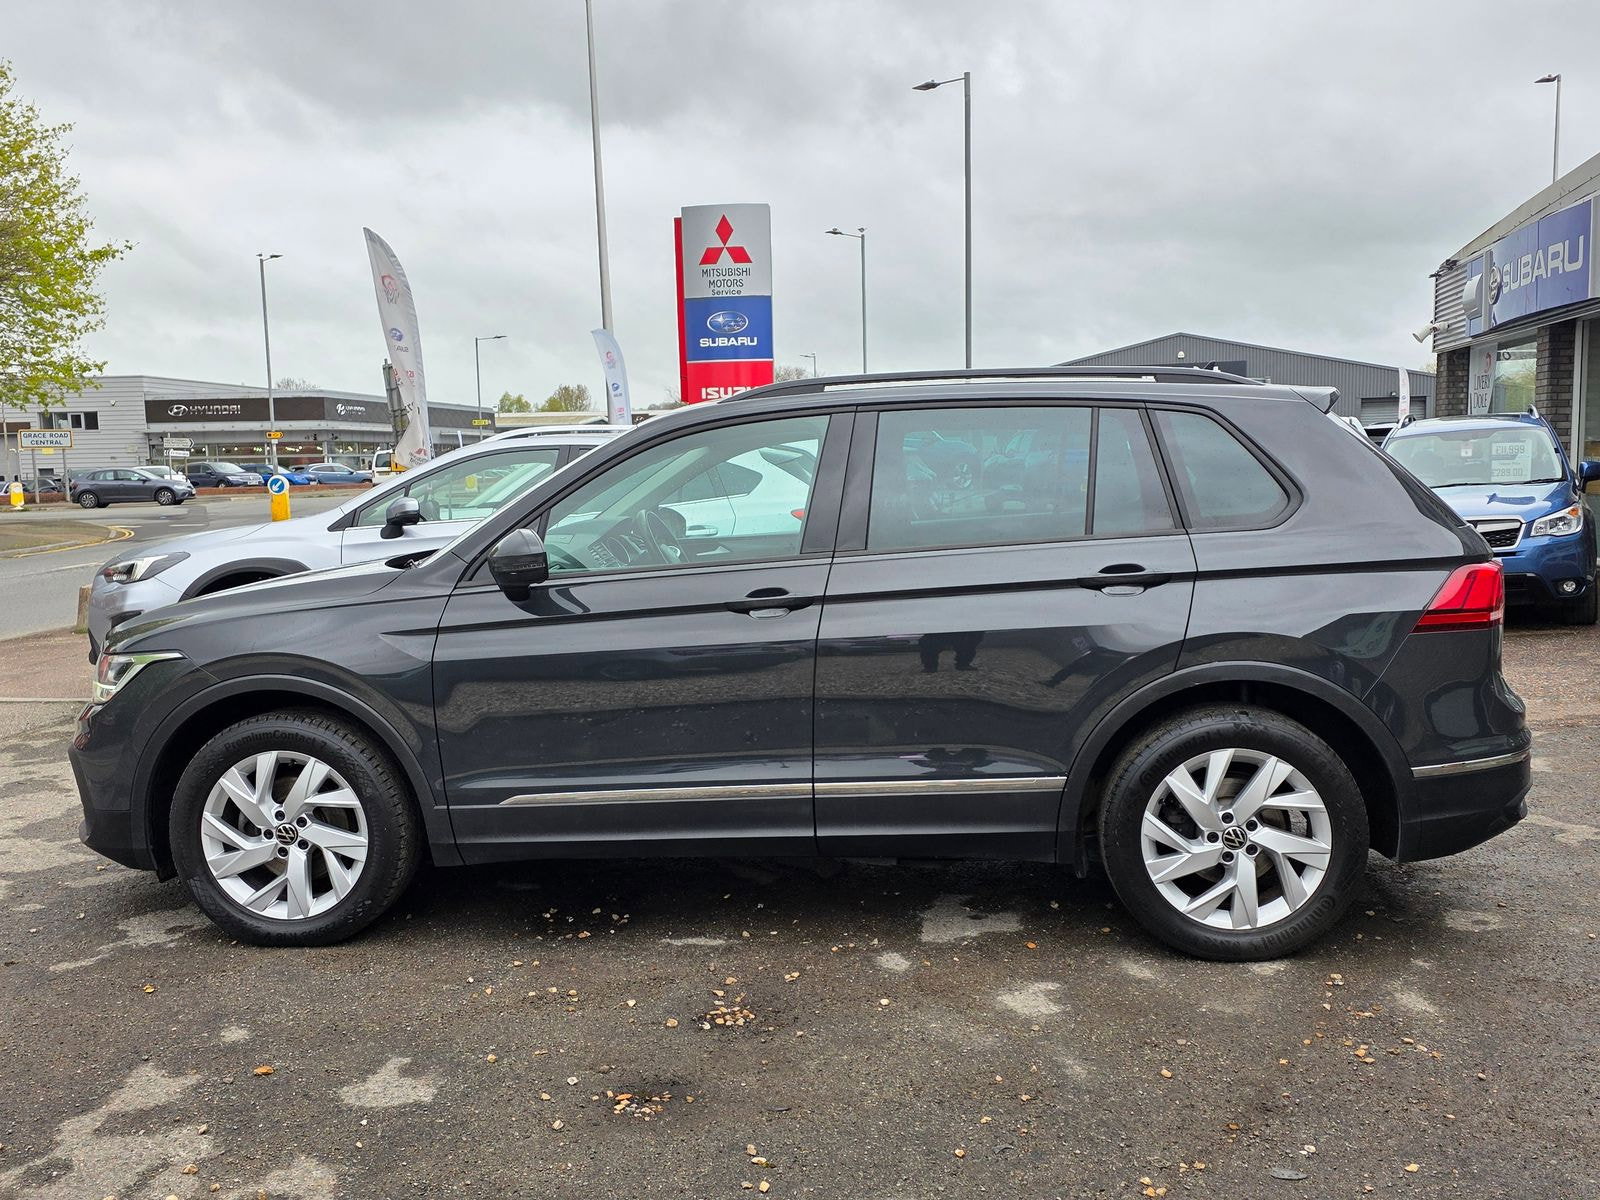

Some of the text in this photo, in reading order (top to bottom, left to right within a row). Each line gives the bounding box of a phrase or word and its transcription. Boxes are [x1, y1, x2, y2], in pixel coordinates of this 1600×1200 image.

[1501, 235, 1584, 295] SUBARU
[701, 267, 751, 278] MITSUBISHI
[708, 278, 744, 288] MOTORS
[711, 288, 742, 296] Service
[699, 336, 758, 347] SUBARU
[701, 386, 753, 400] ISUZ
[189, 404, 241, 415] HYUNDAI
[223, 729, 316, 752] PremiumContact
